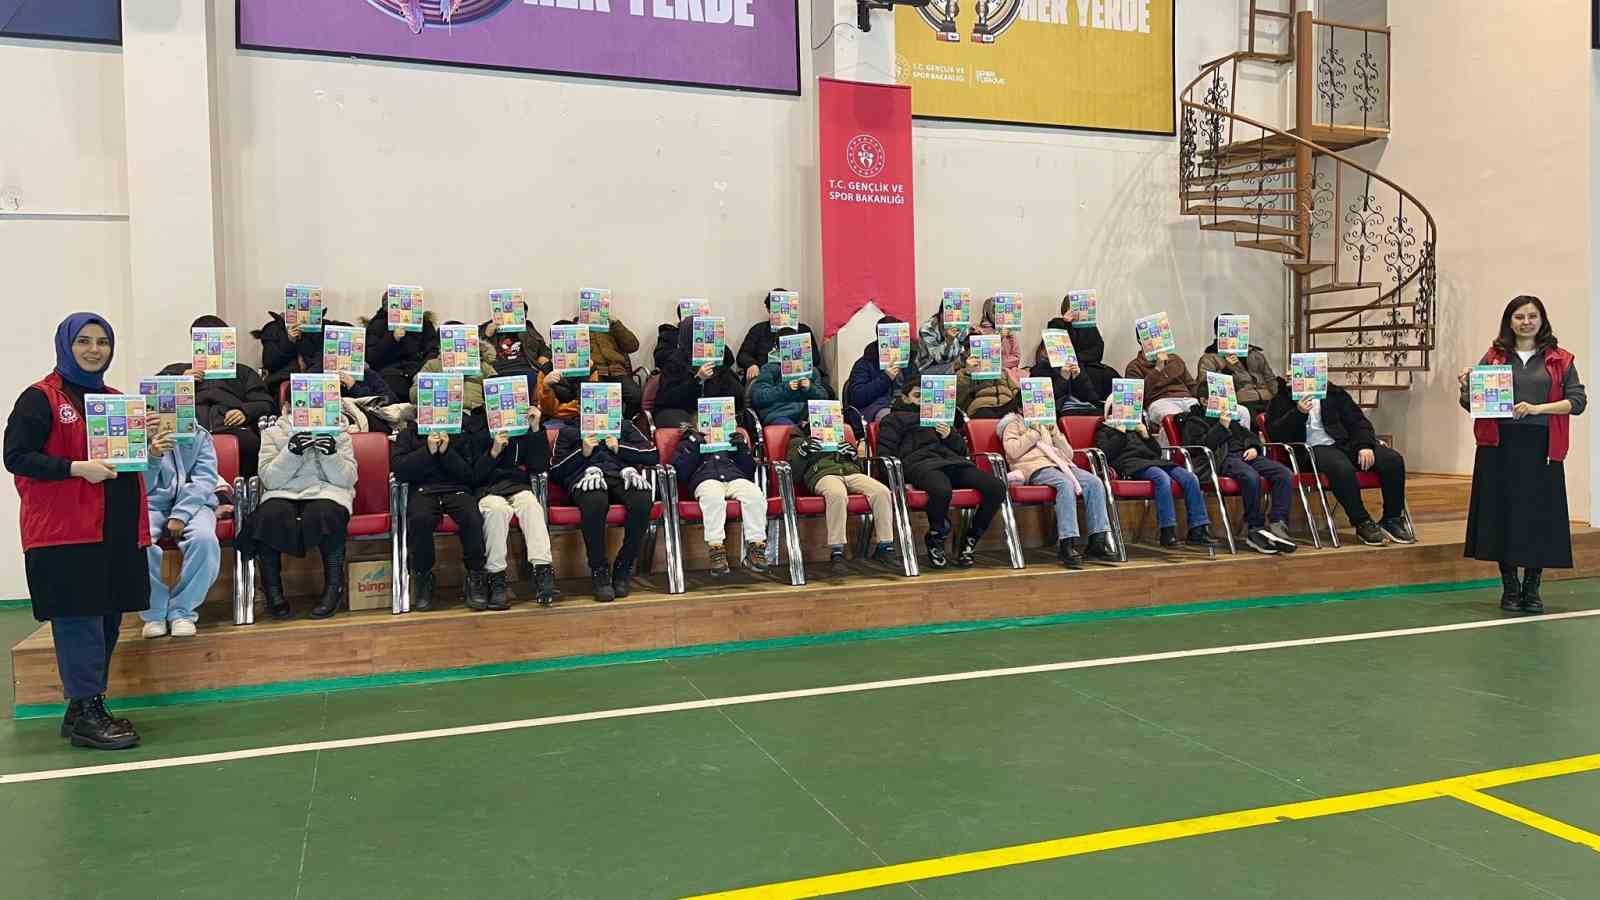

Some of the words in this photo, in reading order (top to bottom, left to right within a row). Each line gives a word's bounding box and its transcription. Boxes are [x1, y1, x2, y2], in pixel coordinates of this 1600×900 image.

[829, 180, 846, 189] T.C.
[848, 181, 890, 193] GENÇLİK
[891, 184, 904, 193] VE
[829, 191, 854, 200] SPOR
[855, 193, 904, 204] BAKANLIĞI
